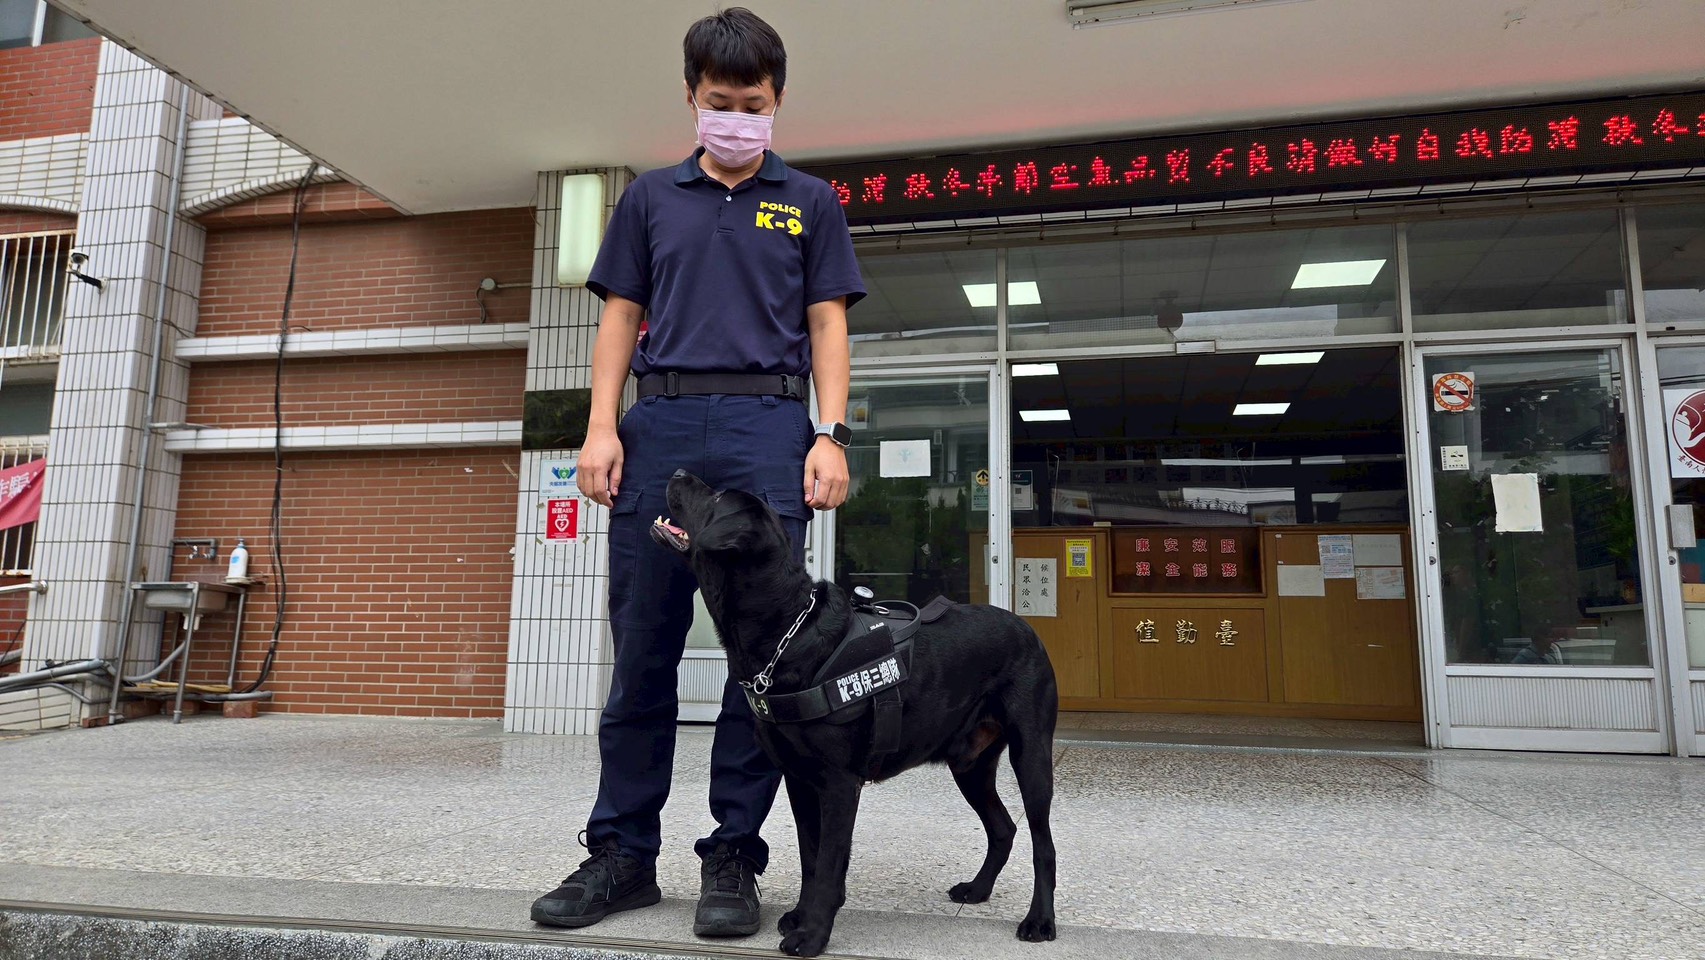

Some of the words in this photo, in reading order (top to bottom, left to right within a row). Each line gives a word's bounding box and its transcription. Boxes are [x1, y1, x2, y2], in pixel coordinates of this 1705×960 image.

[1602, 109, 1705, 146] 秋冬
[755, 211, 803, 236] K-9
[759, 201, 802, 218] POLICE
[1021, 563, 1032, 608] 民眾洽公
[1040, 563, 1050, 597] 候位處
[837, 673, 860, 688] POLICE
